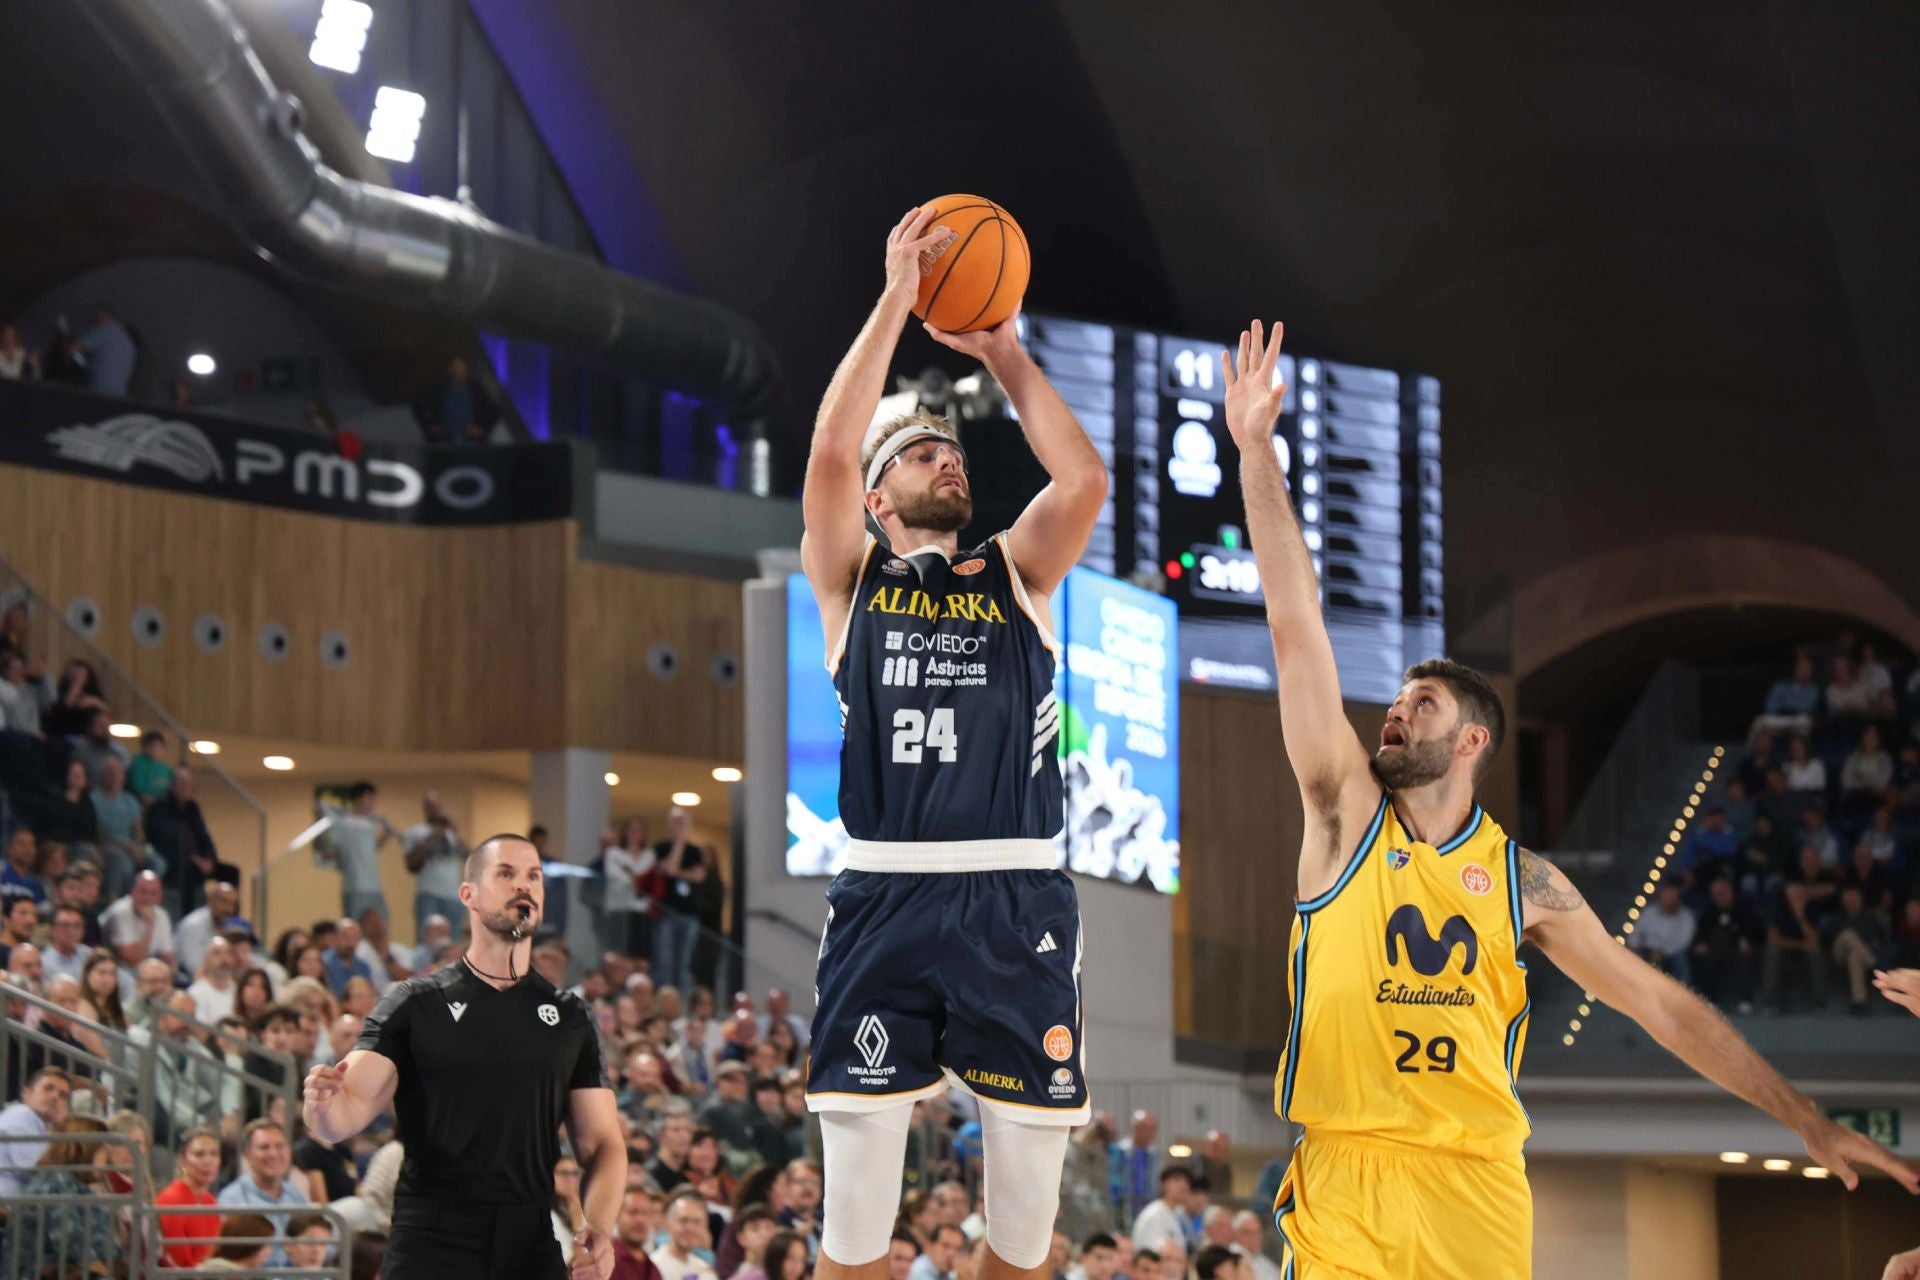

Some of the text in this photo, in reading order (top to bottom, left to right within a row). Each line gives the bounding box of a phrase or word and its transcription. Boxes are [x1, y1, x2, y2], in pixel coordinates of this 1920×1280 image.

[866, 585, 1007, 625] ALIMRKA
[954, 676, 987, 687] natural
[892, 707, 957, 763] 24
[1375, 978, 1475, 1007] Estudiantes
[1394, 1028, 1457, 1073] 29
[859, 1077, 889, 1085] OVIEDO
[963, 1068, 1025, 1092] ALIMERKA
[1048, 1085, 1077, 1094] OVIEDO
